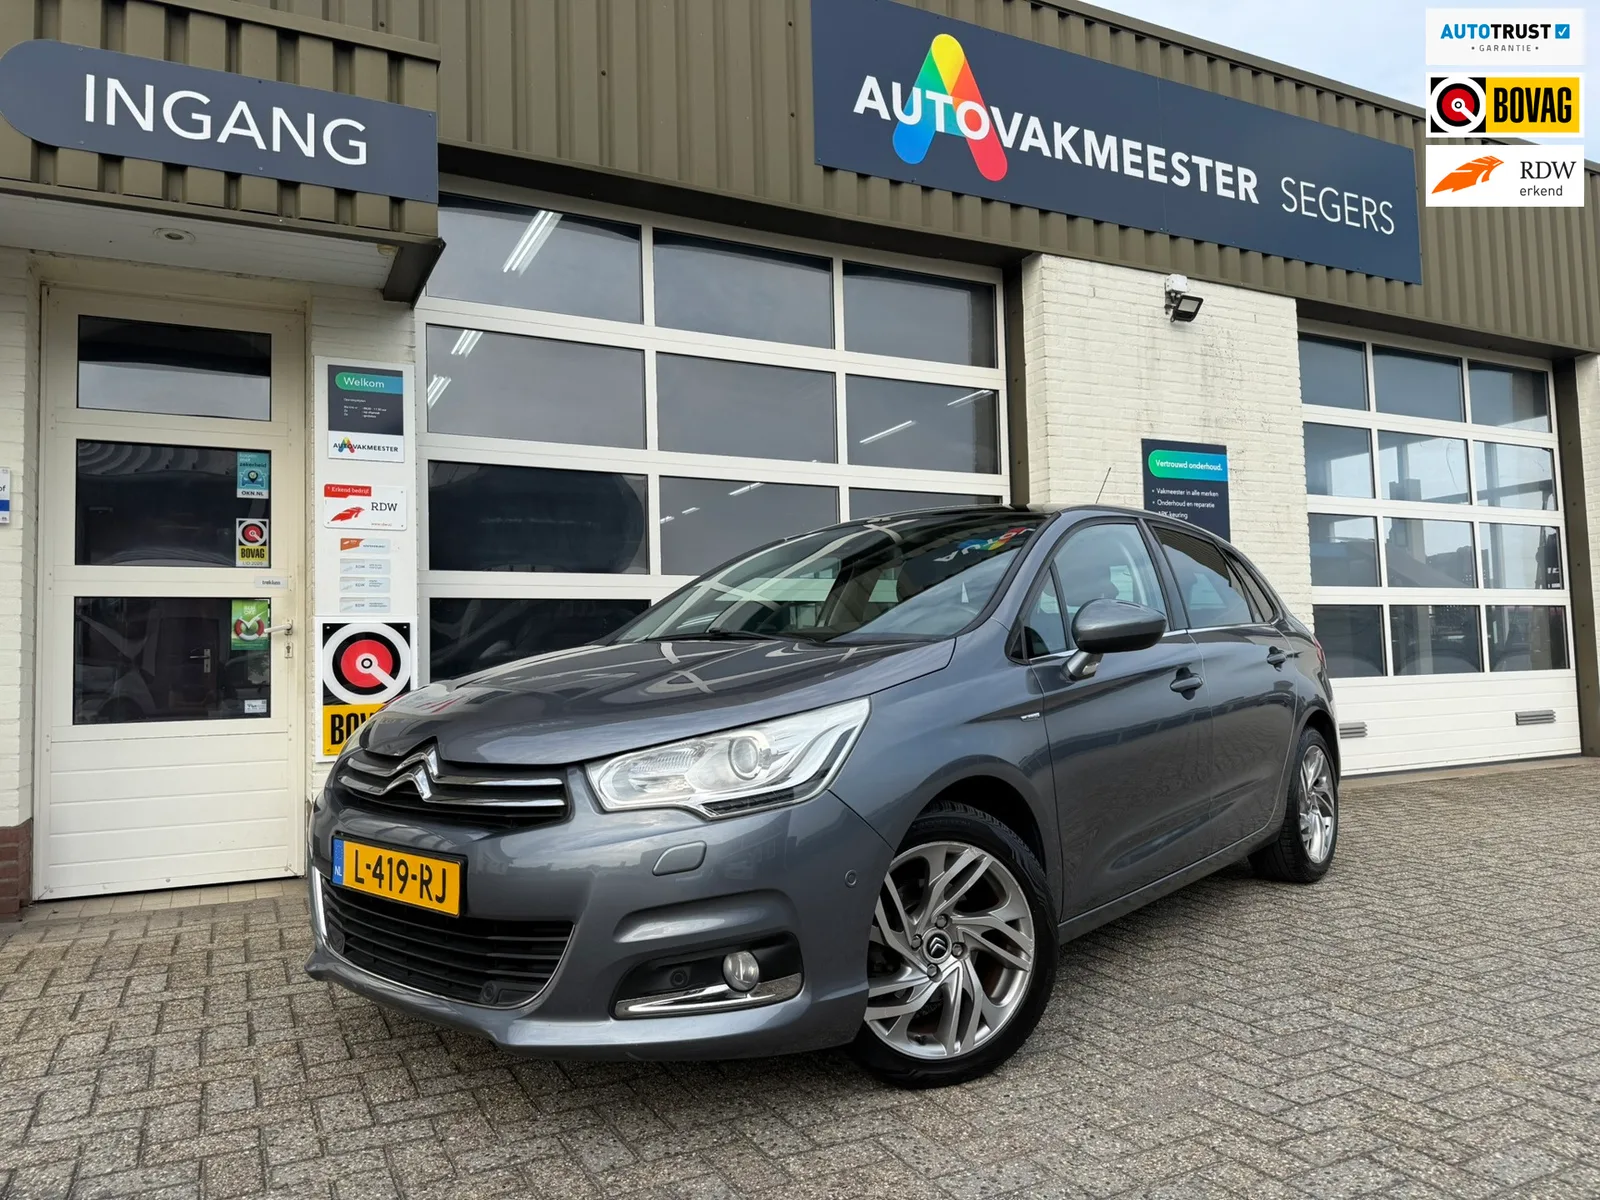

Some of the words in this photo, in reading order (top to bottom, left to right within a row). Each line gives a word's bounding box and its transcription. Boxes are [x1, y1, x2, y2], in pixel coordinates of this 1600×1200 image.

[85, 74, 367, 166] INGANG
[853, 75, 1260, 204] AUTOVAKMEESTER
[1281, 176, 1396, 236] SEGERS
[343, 376, 385, 389] Welkom
[333, 442, 399, 453] AUTOVAKMEESTER
[1155, 459, 1188, 469] Vertrouwd
[1189, 462, 1223, 471] onderhoud.
[351, 487, 370, 495] bedrijf
[371, 502, 398, 512] RDW
[1156, 499, 1186, 507] Onderhoud
[240, 547, 265, 559] BOVAG
[334, 865, 343, 877] NL
[354, 849, 447, 904] L-419-RJ
